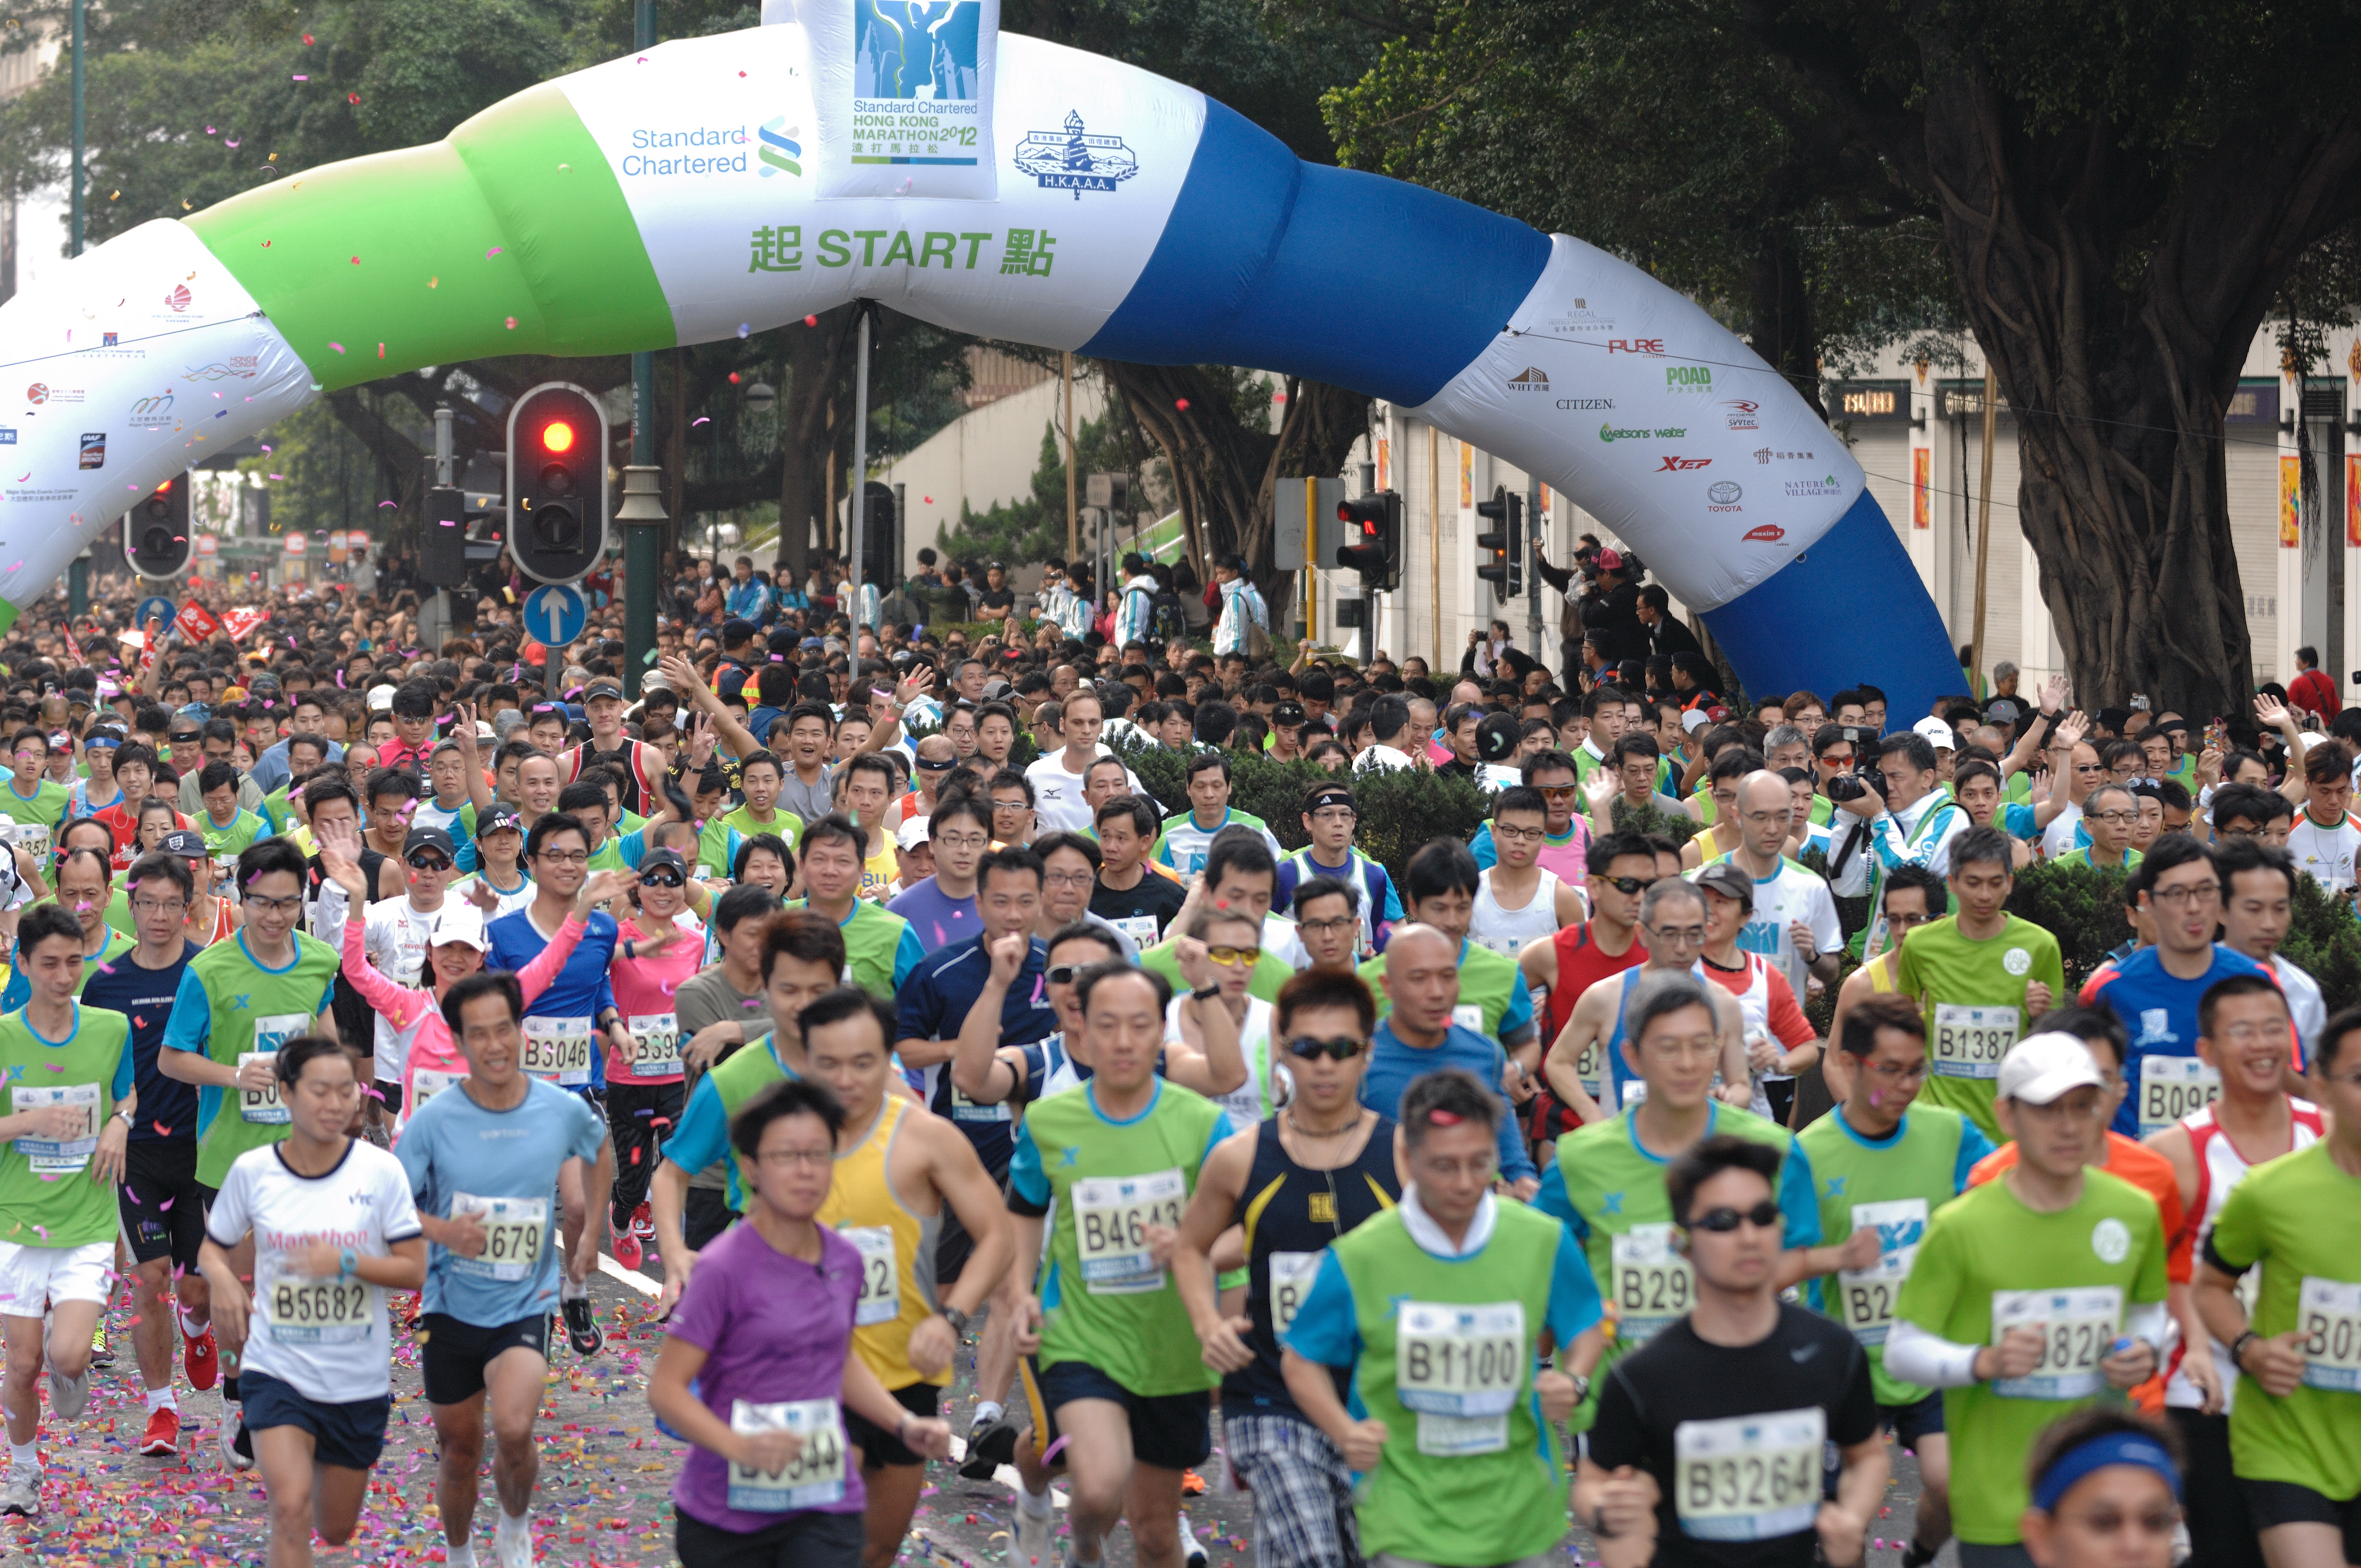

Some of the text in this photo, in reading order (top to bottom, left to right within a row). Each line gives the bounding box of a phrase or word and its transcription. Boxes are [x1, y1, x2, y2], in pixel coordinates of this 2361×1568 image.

[853, 100, 977, 115] Standard Chartered
[853, 115, 939, 127] HONG KONG
[632, 126, 746, 149] Standard
[853, 126, 978, 146] MARATHON 2012
[852, 143, 938, 154] 渣打馬拉松
[622, 151, 747, 176] Chartered
[1045, 175, 1109, 190] H.K.A.A.A.
[747, 225, 802, 274] 起
[815, 229, 993, 270] START
[998, 228, 1057, 277] 點
[1608, 339, 1664, 354] PURE
[1666, 366, 1711, 385] POAD
[1507, 383, 1532, 391] WHT
[1556, 399, 1613, 410] CITIZEN
[1603, 427, 1687, 439] watsons water
[1653, 456, 1712, 472] XTEP
[525, 1038, 587, 1068] B3046
[1940, 1027, 2013, 1059] B1387
[277, 1284, 364, 1321] B5682
[1407, 1340, 1519, 1386] B1100
[1686, 1453, 1813, 1510] B3264
